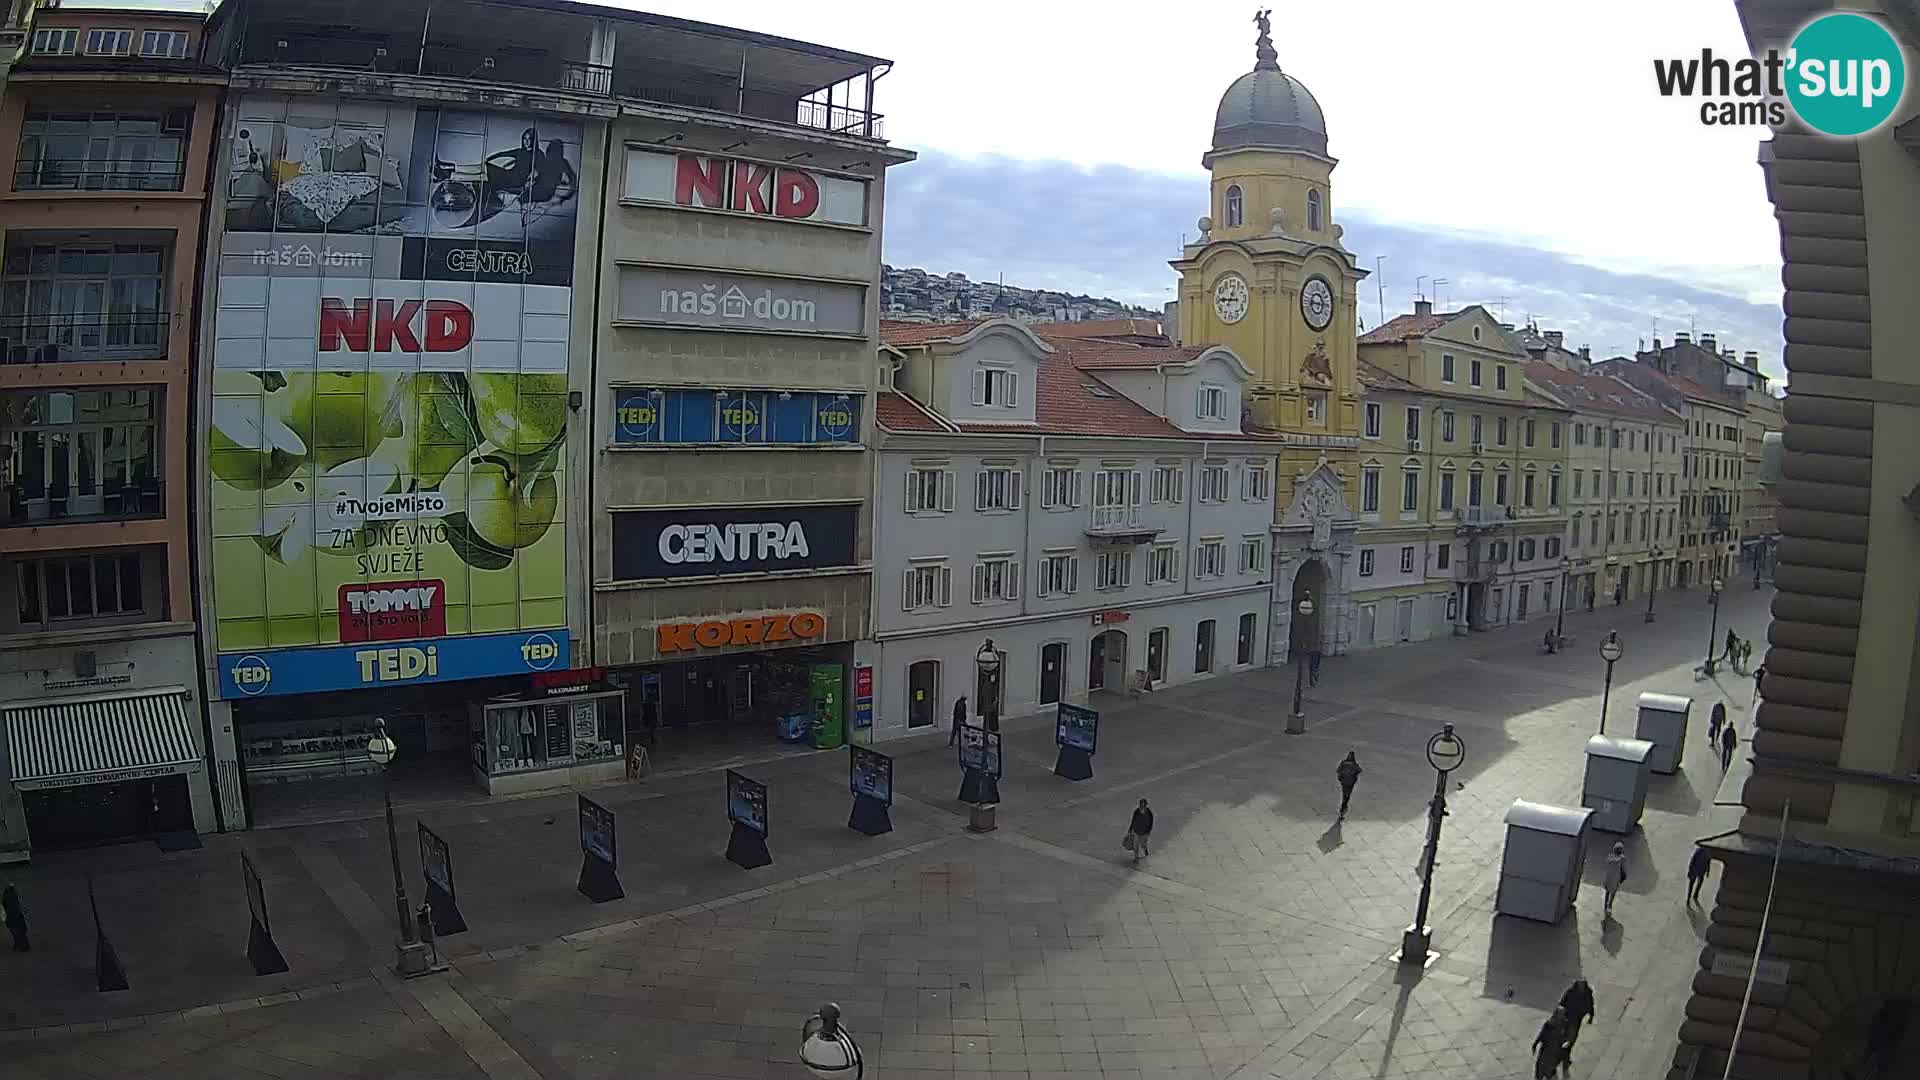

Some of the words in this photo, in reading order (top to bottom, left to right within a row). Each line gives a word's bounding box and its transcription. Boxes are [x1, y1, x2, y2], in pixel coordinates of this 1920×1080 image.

[674, 156, 820, 219] NKD
[252, 244, 291, 266] naš
[317, 245, 364, 268] dom
[446, 249, 533, 274] CENTRA
[659, 282, 717, 315] naš
[753, 288, 817, 323] dom
[318, 297, 475, 353] NKD
[617, 406, 656, 424] TEDi
[722, 408, 760, 425] TEDi
[819, 410, 852, 426] TEDi
[336, 496, 445, 515] #TvojeMisto
[332, 529, 355, 548] ZA
[364, 524, 448, 548] DNEVNO
[658, 521, 810, 564] CENTRA
[357, 548, 425, 575] SVJEŽE
[347, 586, 437, 614] TOMMY
[658, 613, 825, 653] KORZO
[355, 645, 438, 682] TEDi
[520, 642, 559, 660] TEDi
[231, 663, 272, 685] TEDi
